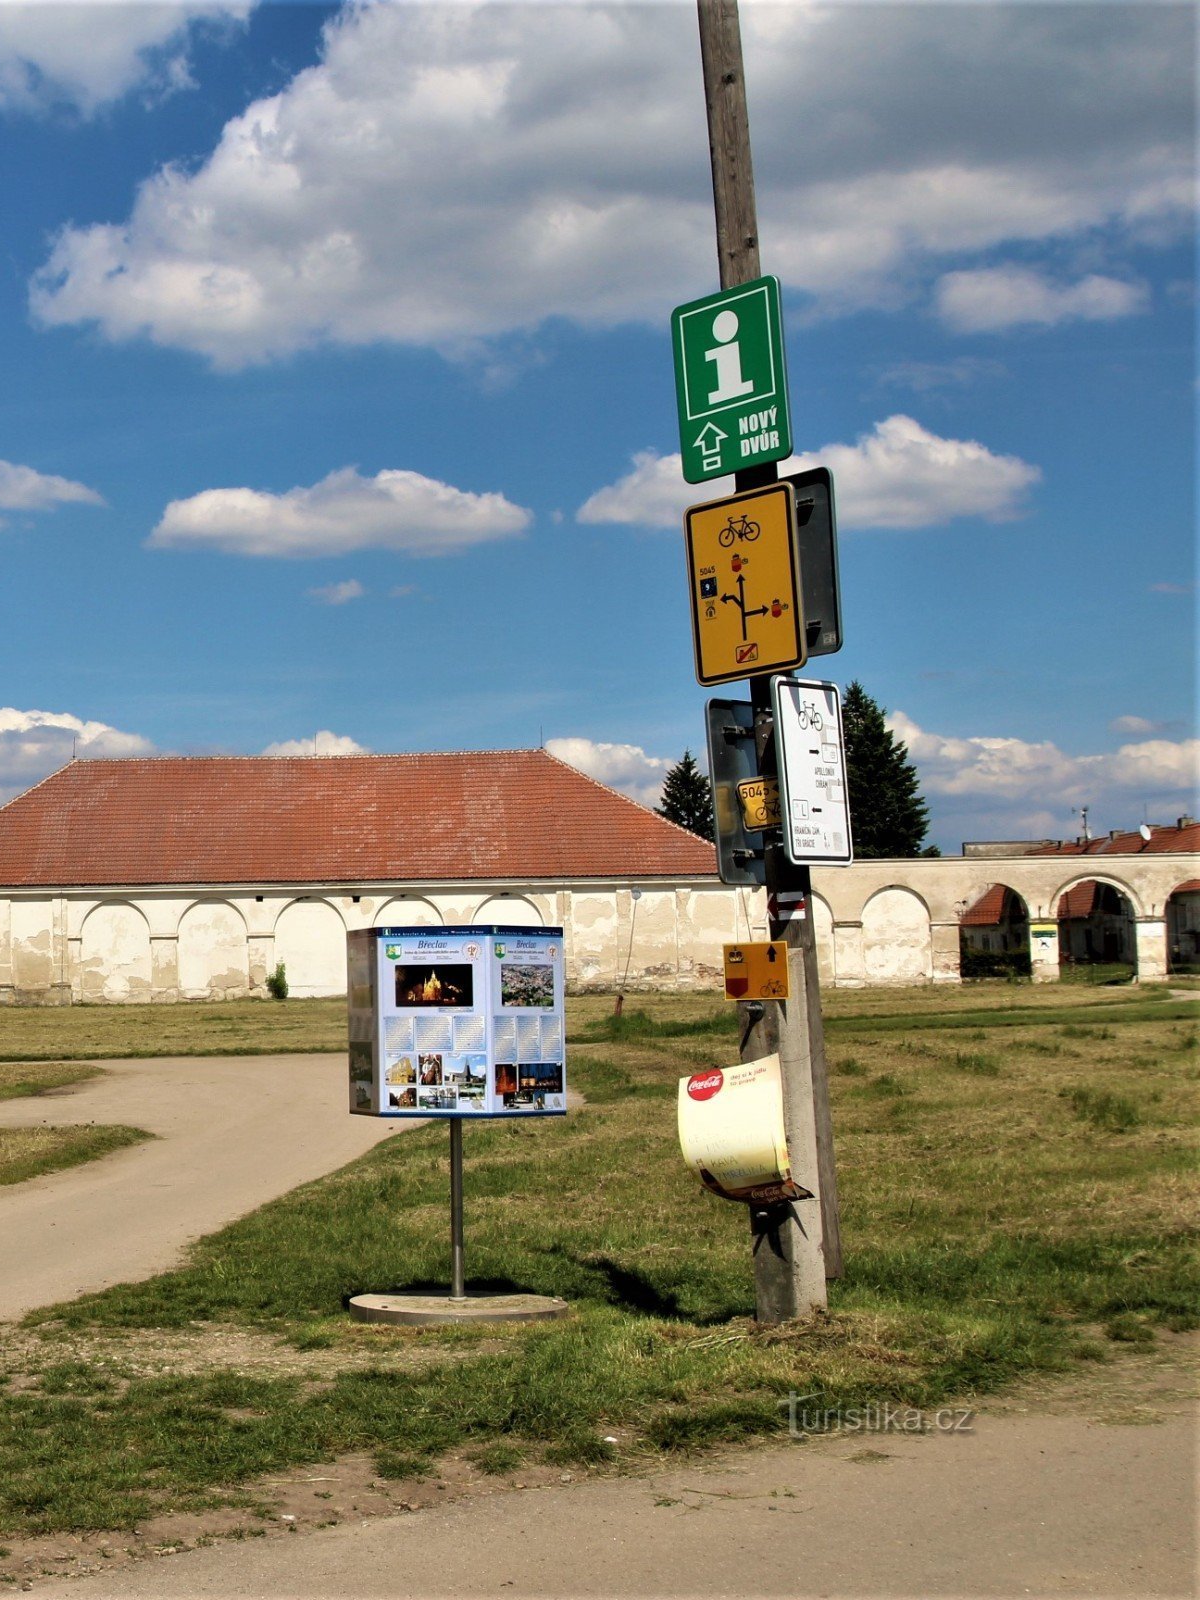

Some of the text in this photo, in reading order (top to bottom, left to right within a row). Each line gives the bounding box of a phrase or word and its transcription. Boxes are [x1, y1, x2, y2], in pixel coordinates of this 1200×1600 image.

[738, 405, 778, 435] NOVÝ
[740, 429, 780, 458] DVŮR
[699, 565, 716, 576] 5045
[417, 940, 448, 949] Břeclav
[516, 939, 537, 949] Břeclav
